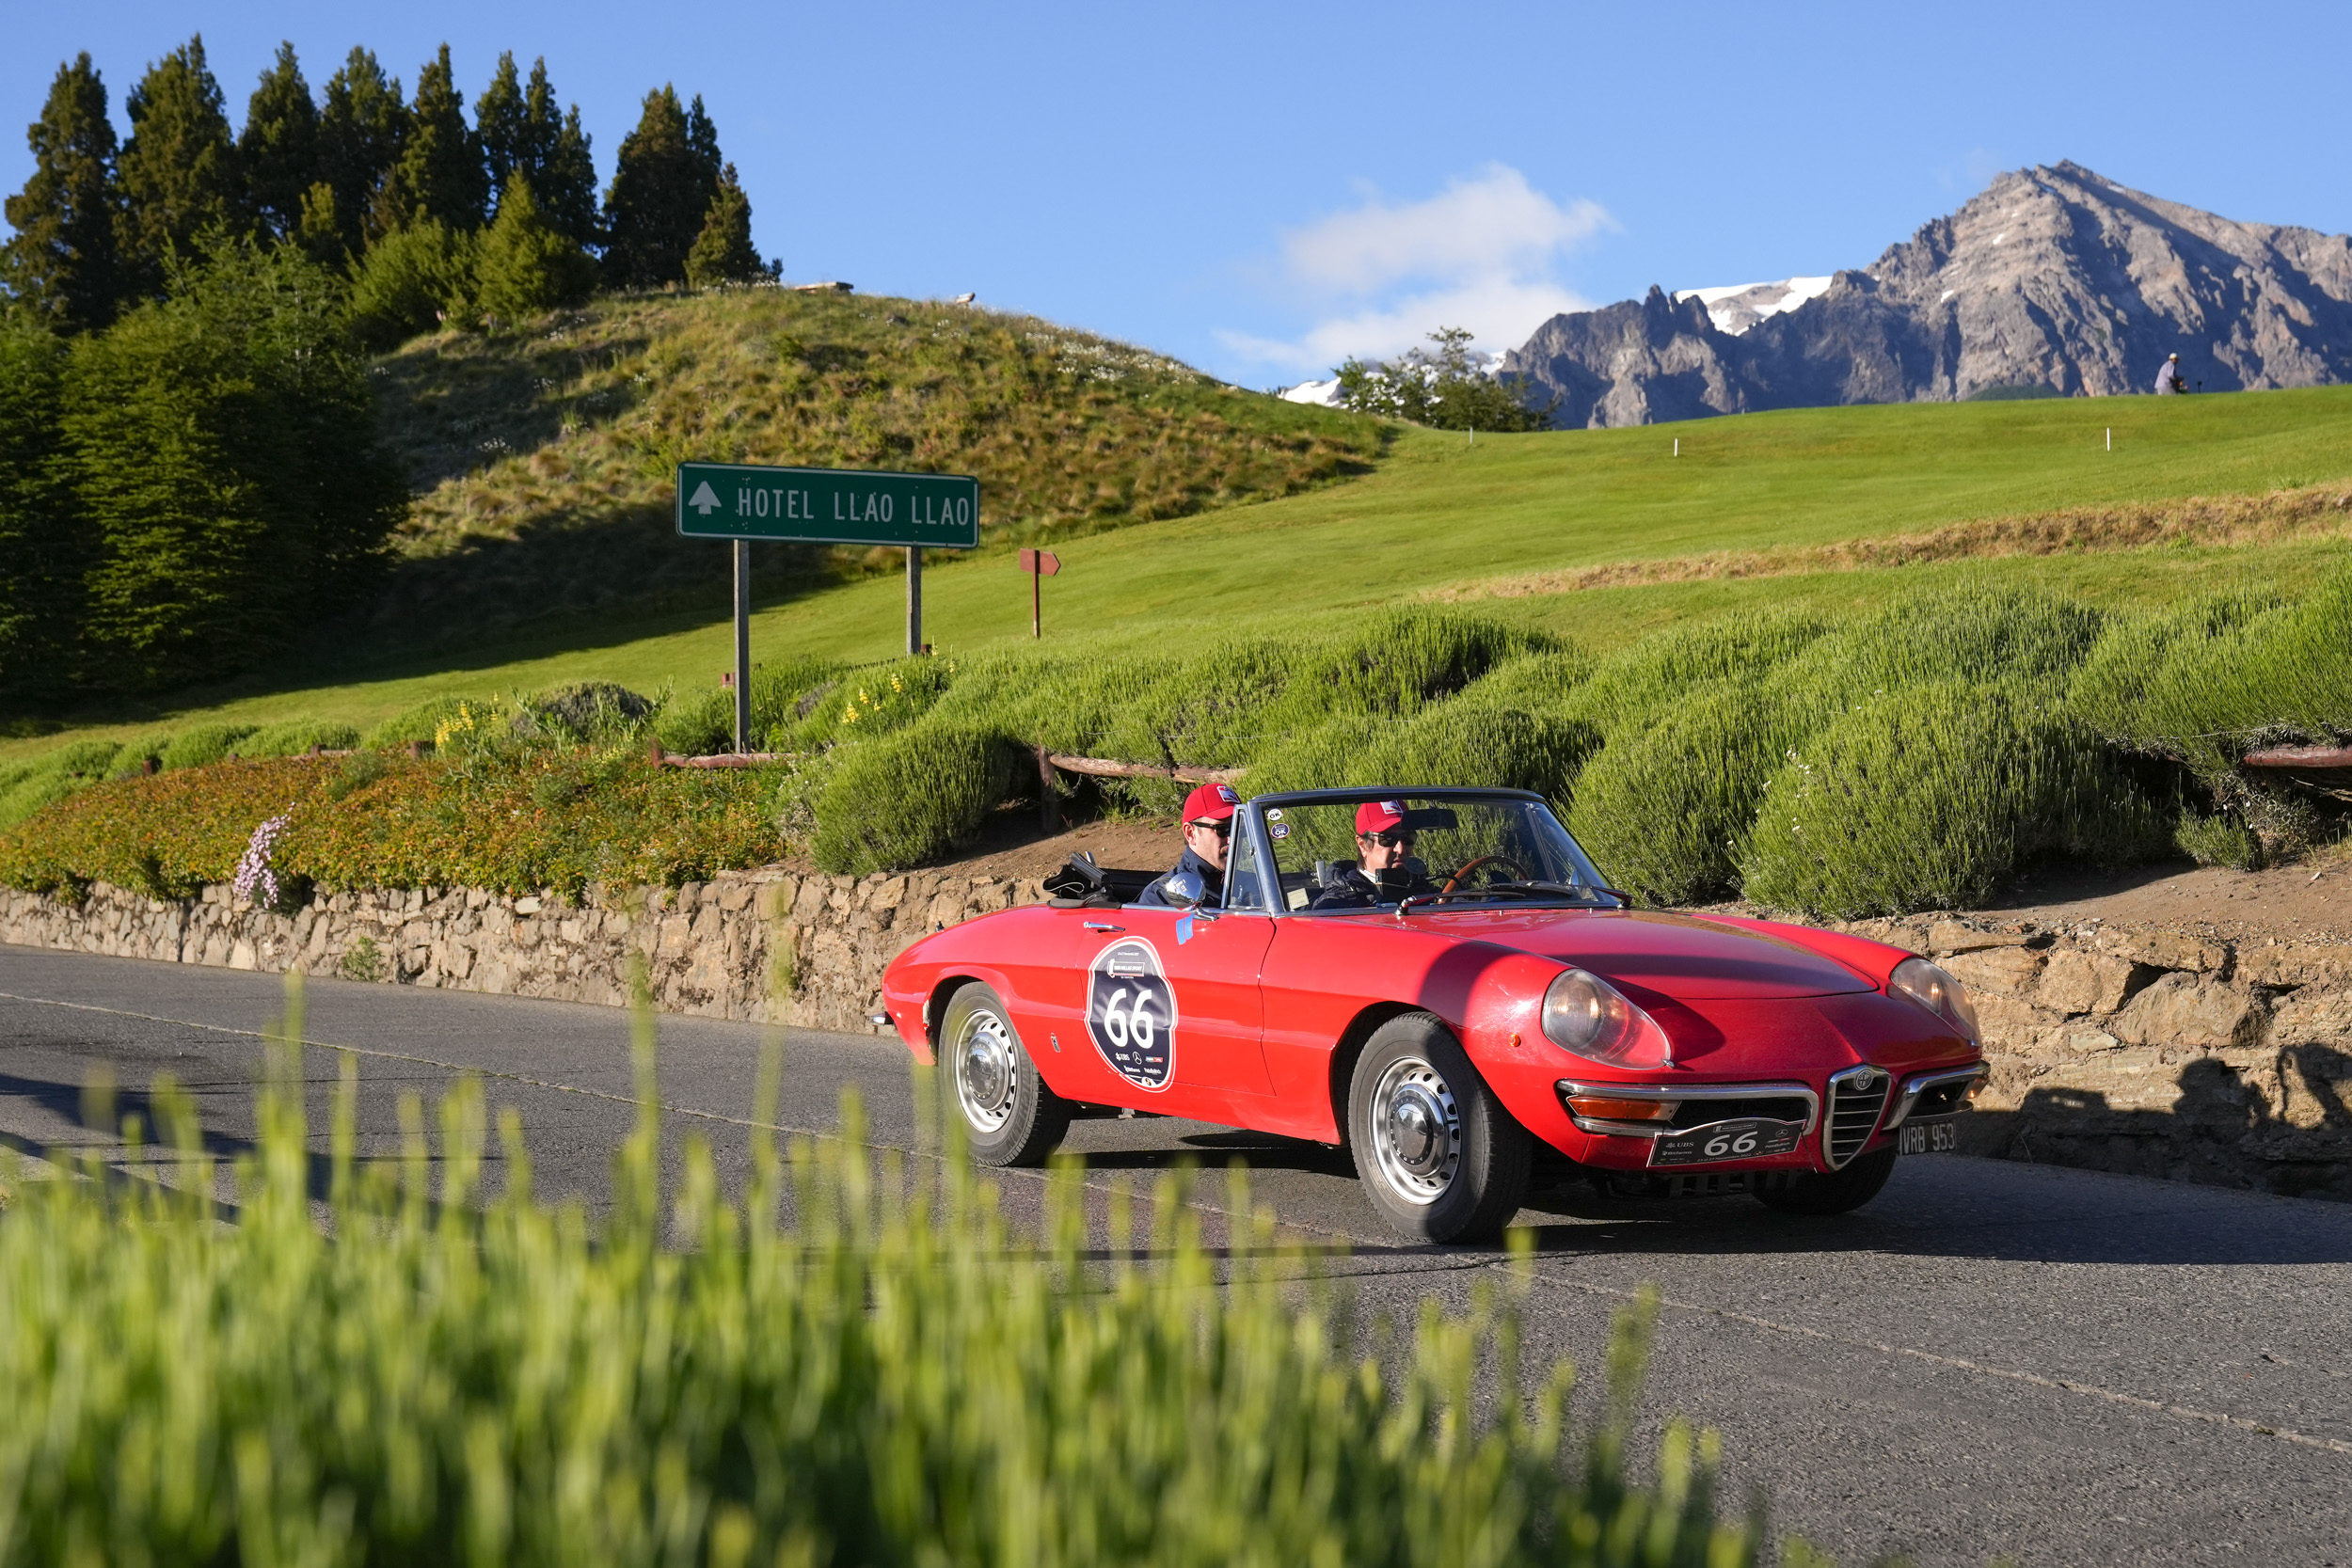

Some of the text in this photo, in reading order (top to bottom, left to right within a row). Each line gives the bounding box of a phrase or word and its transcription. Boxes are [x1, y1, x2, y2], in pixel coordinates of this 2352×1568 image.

[738, 487, 970, 526] HOTEL LLAO LLAO
[1104, 989, 1154, 1049] 66
[1704, 1131, 1758, 1157] 66
[1902, 1122, 1955, 1154] VRB 953
